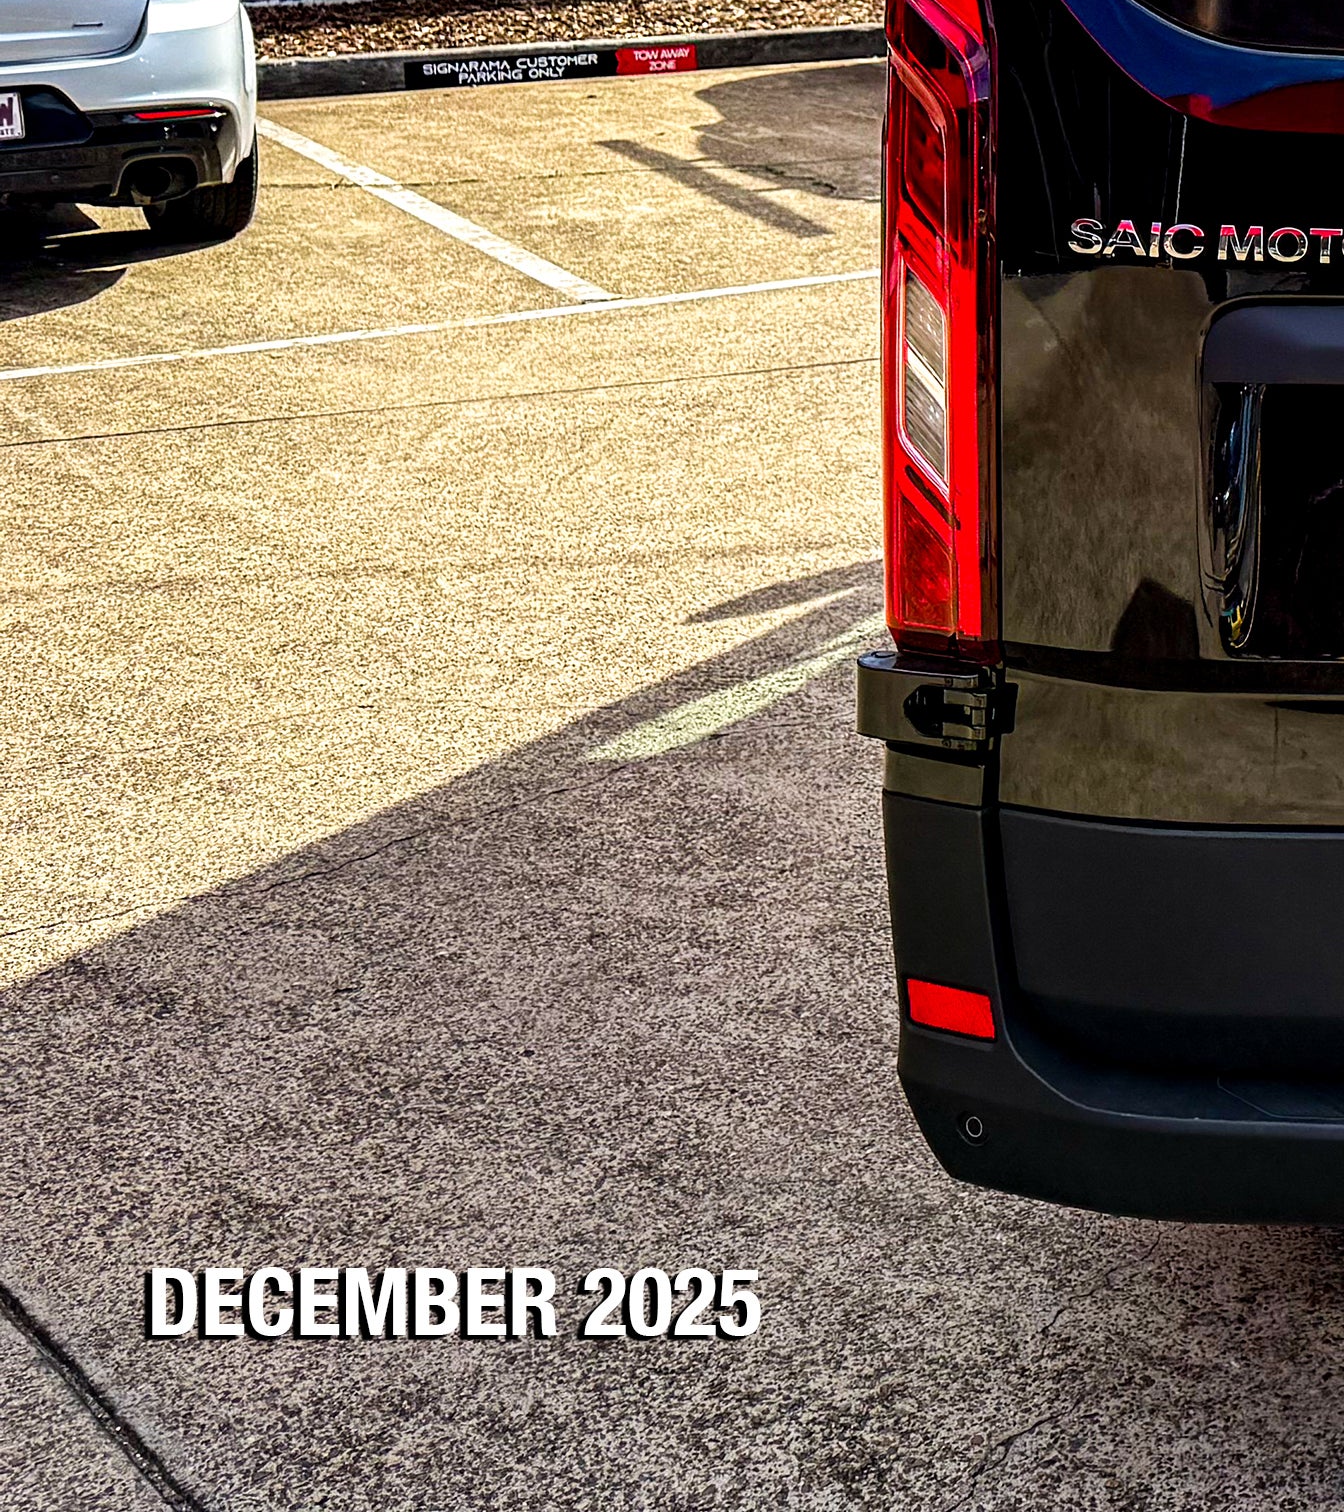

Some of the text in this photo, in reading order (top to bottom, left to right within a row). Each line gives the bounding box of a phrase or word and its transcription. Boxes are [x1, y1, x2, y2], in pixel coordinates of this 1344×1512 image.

[633, 48, 690, 61] TOW AWAY
[422, 53, 598, 76] SIGNARAMA CUSTOMER
[649, 60, 676, 71] ZONE
[458, 66, 564, 84] PARKING ONLY
[1067, 217, 1205, 261] SAIC
